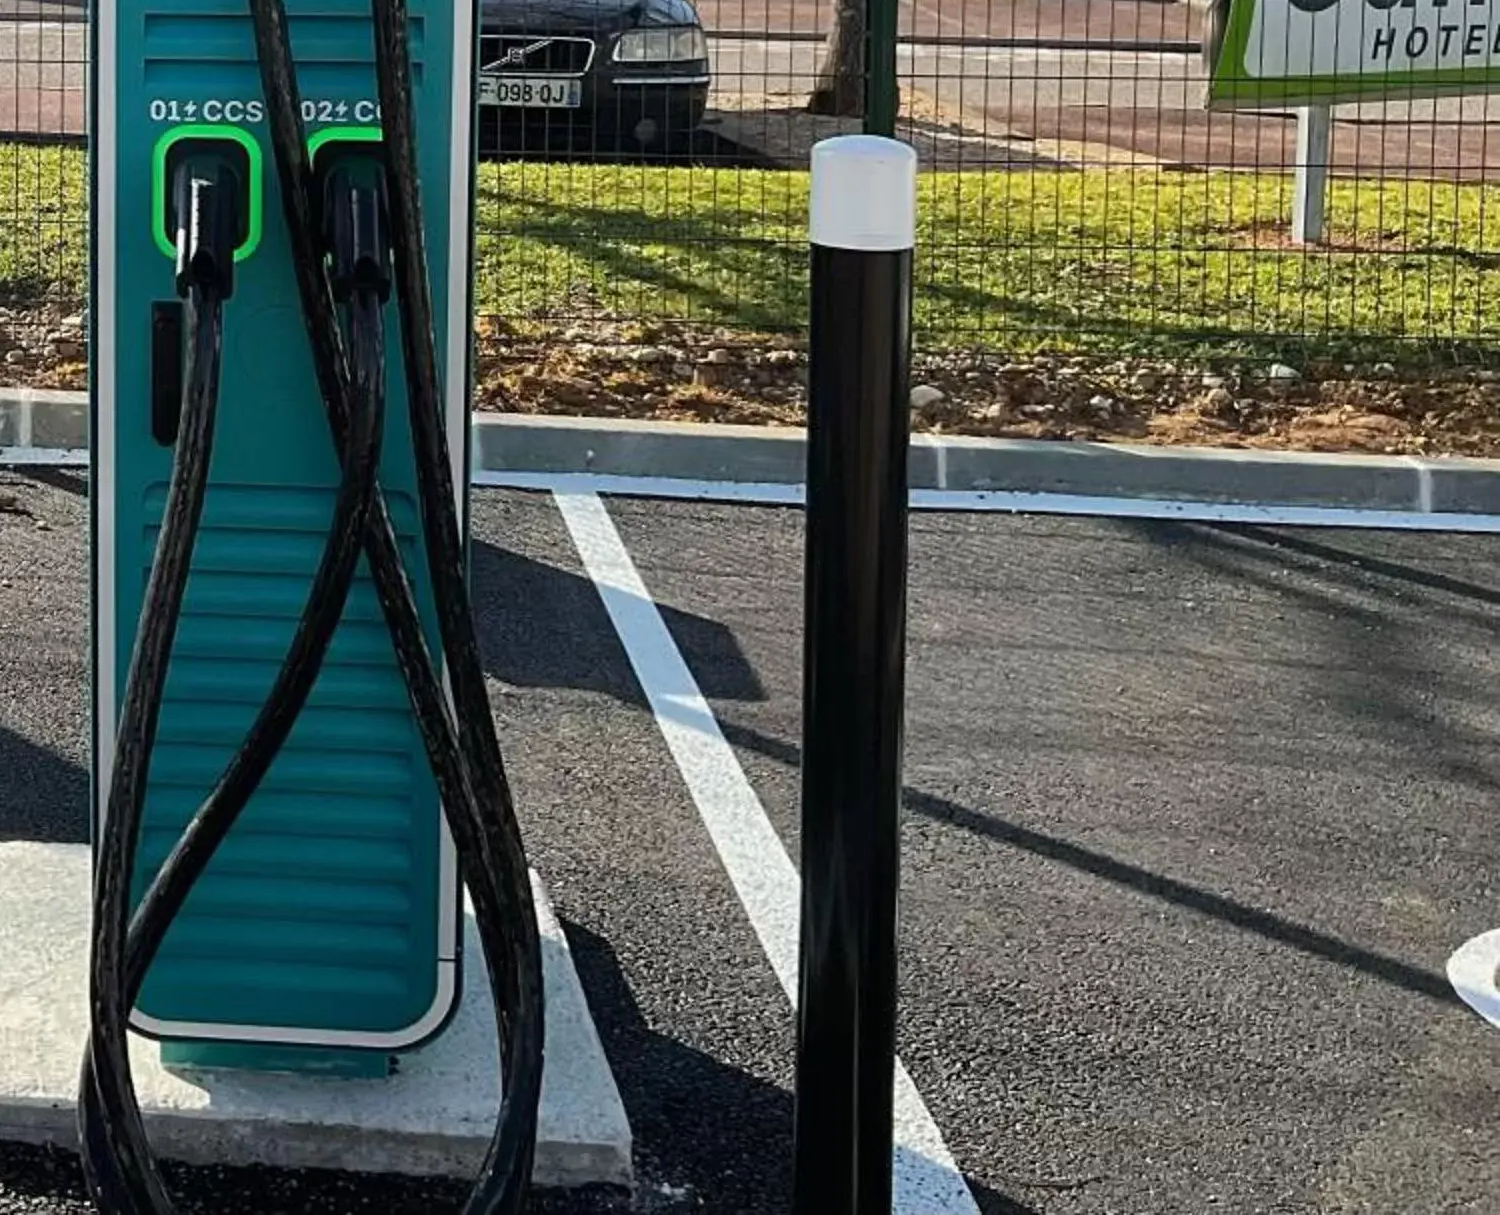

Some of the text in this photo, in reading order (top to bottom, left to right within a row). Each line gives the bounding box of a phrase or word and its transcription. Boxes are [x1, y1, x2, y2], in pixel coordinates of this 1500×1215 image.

[150, 99, 263, 122] 01 CCS
[301, 100, 333, 121] 02
